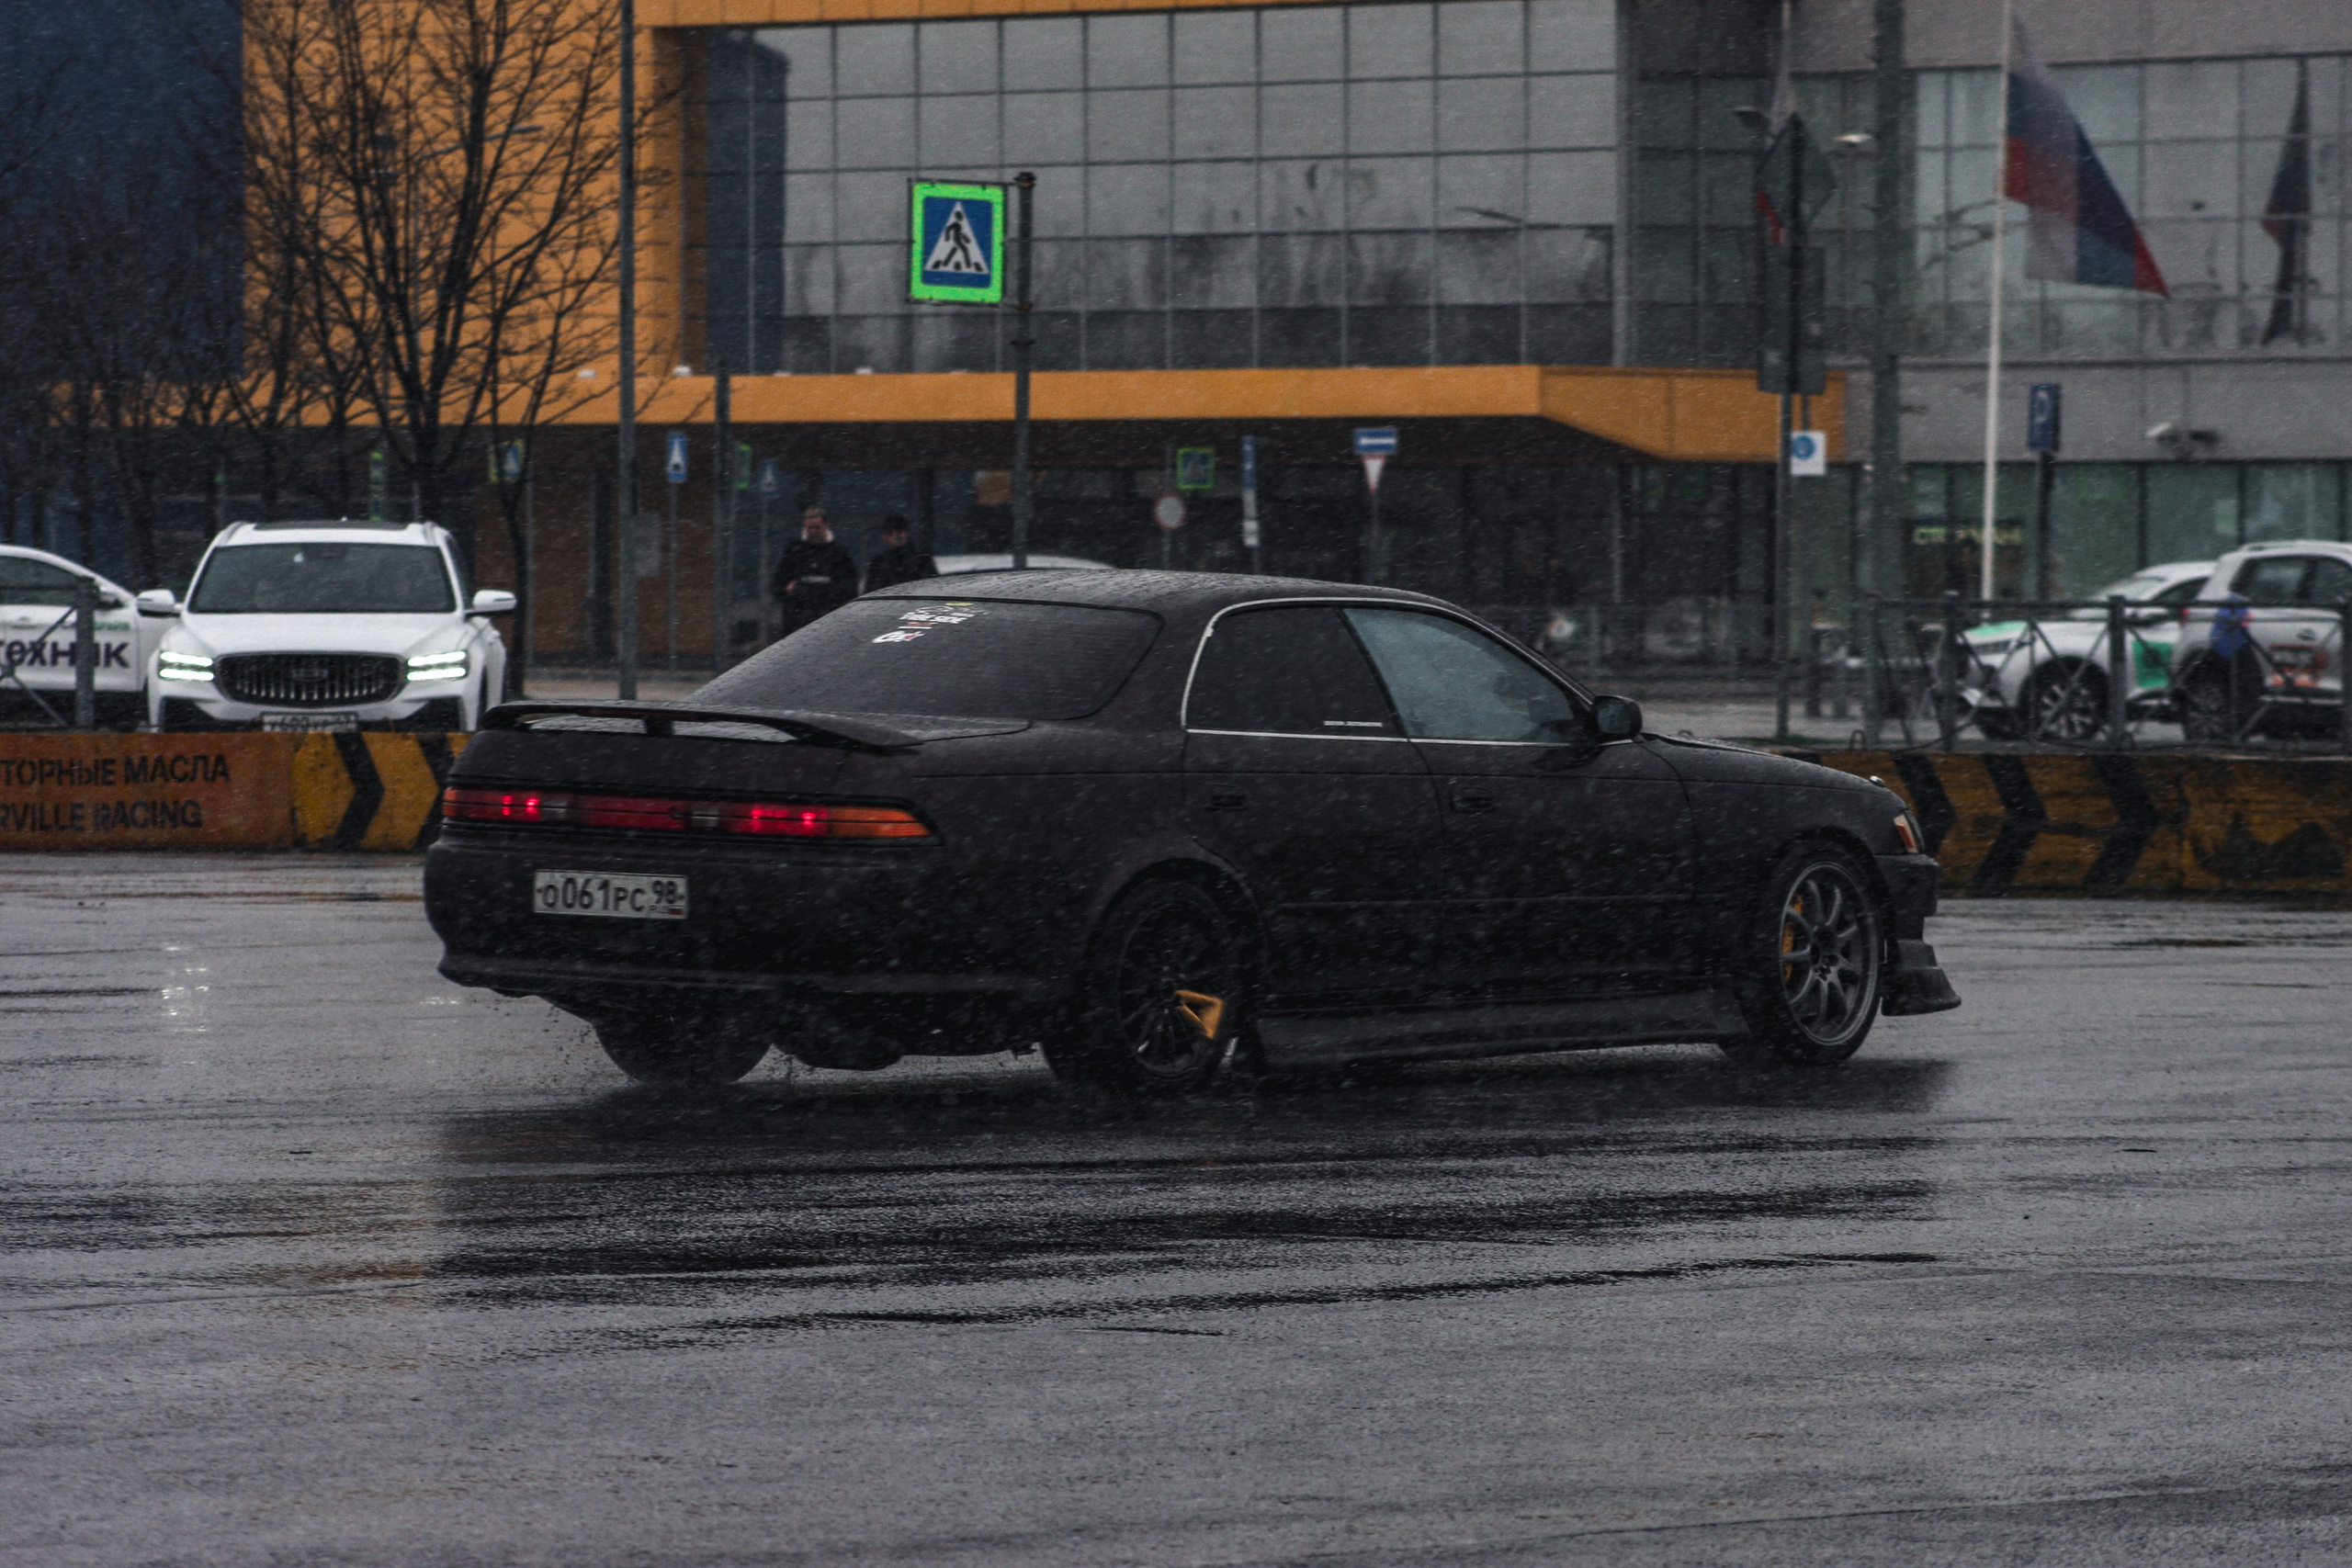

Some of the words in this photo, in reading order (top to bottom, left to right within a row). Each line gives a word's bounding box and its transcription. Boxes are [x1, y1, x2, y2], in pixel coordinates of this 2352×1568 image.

[0, 640, 129, 668] ехнк
[0, 758, 117, 786] ТОРНЫЕ
[123, 754, 232, 784] МАСЛА
[93, 798, 203, 833] RACING
[651, 879, 678, 905] 98
